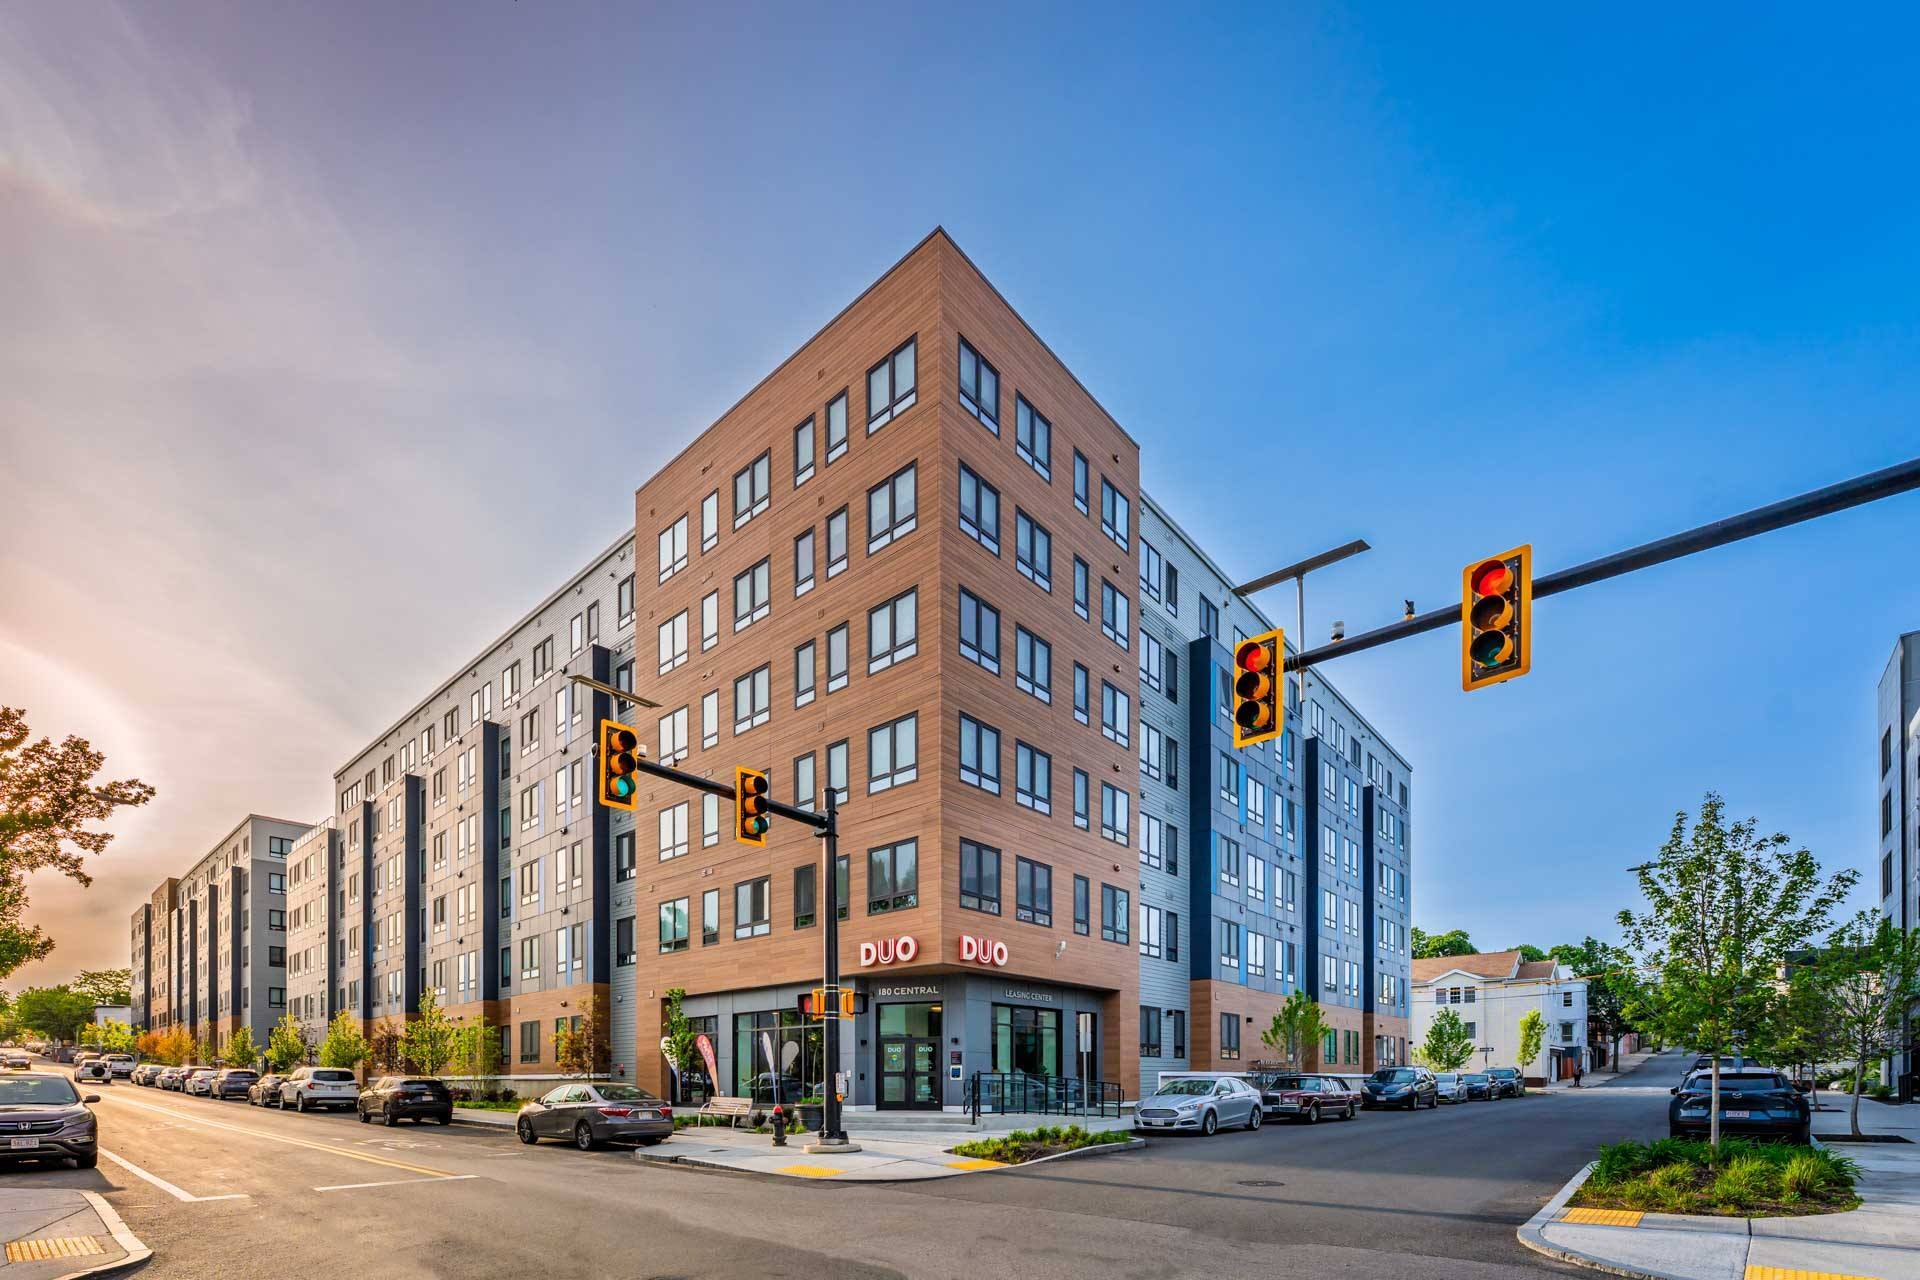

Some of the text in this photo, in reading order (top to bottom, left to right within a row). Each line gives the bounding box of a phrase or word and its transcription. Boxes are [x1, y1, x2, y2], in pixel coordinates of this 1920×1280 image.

[860, 935, 918, 966] DUO
[959, 935, 1009, 966] DUO
[878, 986, 939, 996] 180 CENTRAL
[1005, 988, 1053, 1002] LEASING CENTER
